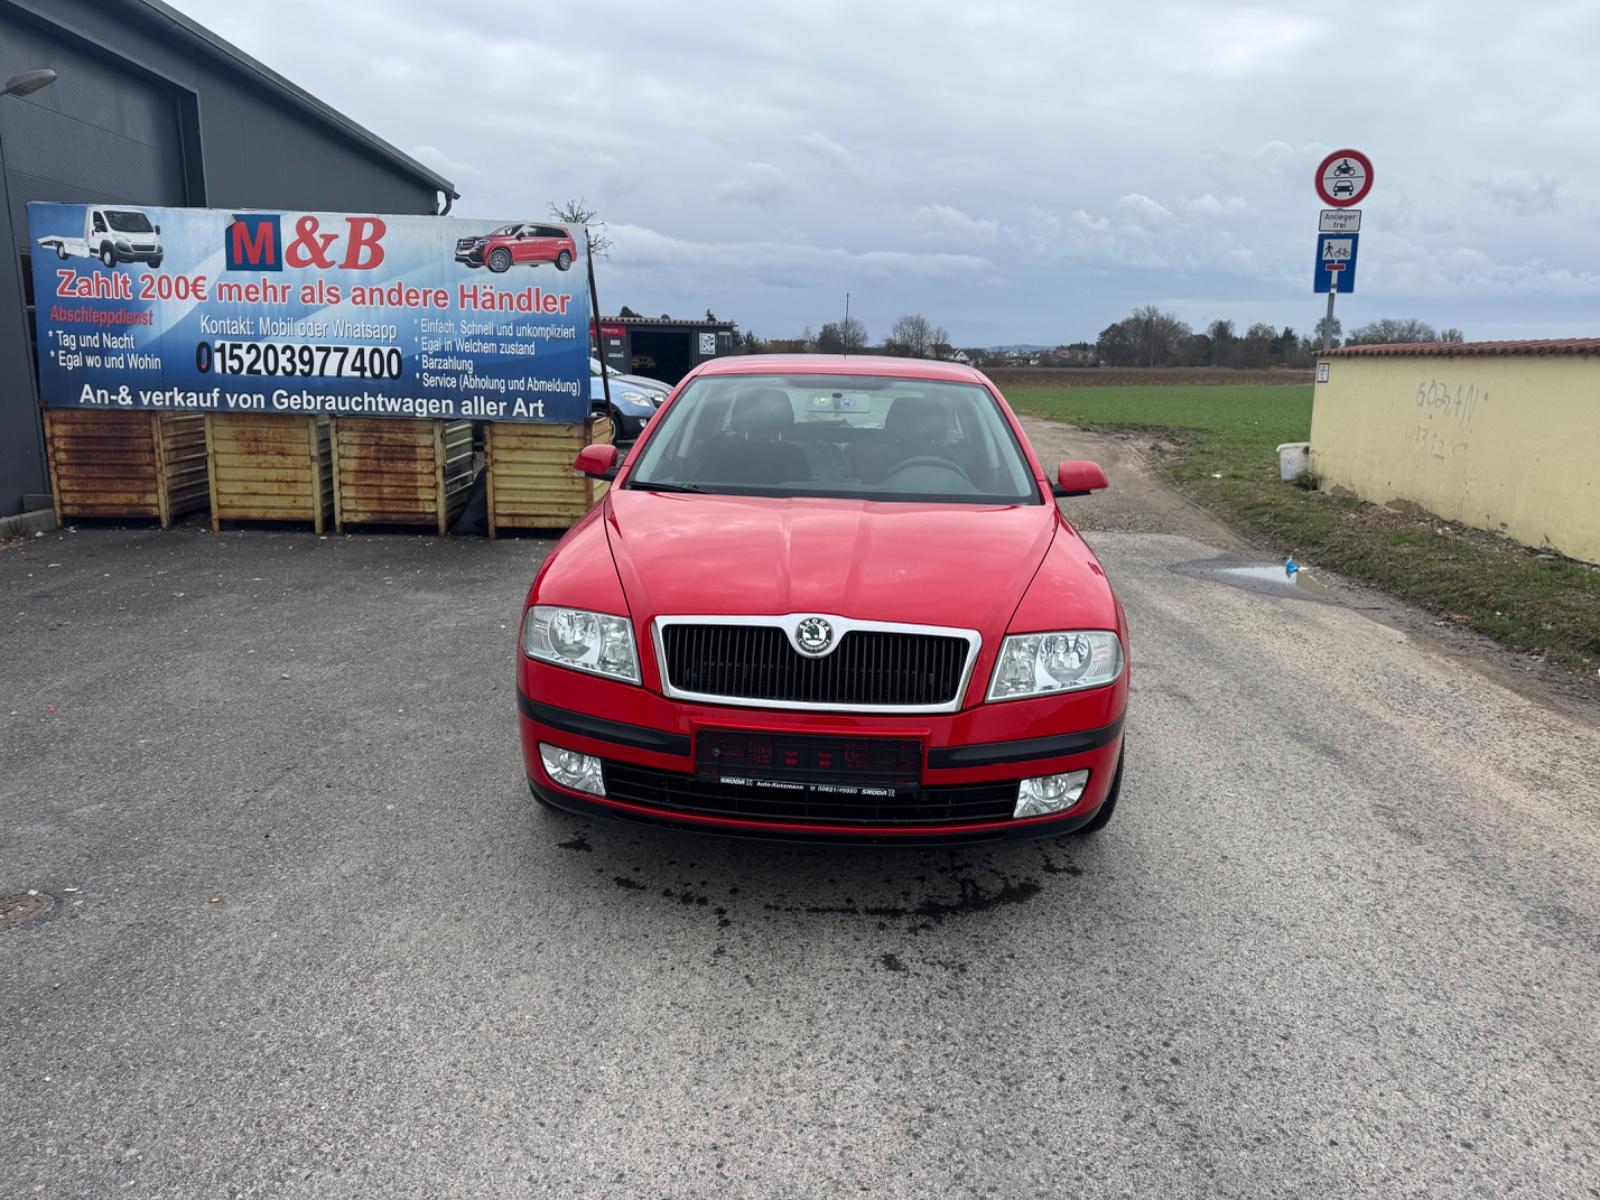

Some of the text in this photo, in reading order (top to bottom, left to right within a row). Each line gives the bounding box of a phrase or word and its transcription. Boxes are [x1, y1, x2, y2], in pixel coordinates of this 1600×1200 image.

[1324, 213, 1357, 223] Anlieger
[1333, 221, 1347, 229] frei
[57, 269, 572, 314] Zahlt 200€ mehr als andere Händler
[50, 305, 153, 327] Abschleppdienst
[201, 315, 397, 342] Kontakt: Mobil oder Whatsapp
[460, 320, 494, 336] Schnell
[496, 321, 513, 337] und
[515, 323, 576, 341] unkompliziert
[57, 330, 135, 350] Tag und Nacht
[421, 336, 536, 356] Egal in Welchem zustand
[58, 351, 161, 371] Egal wo und Wohin
[195, 341, 403, 380] 015203977400
[422, 355, 474, 374] Barzahlung
[422, 373, 581, 397] Service (Abholung und Abmeldung)
[139, 387, 220, 409] verkauf
[222, 392, 265, 410] von
[272, 389, 454, 417] Gebrauchtwagen
[460, 396, 508, 416] aller
[512, 397, 545, 418] Art
